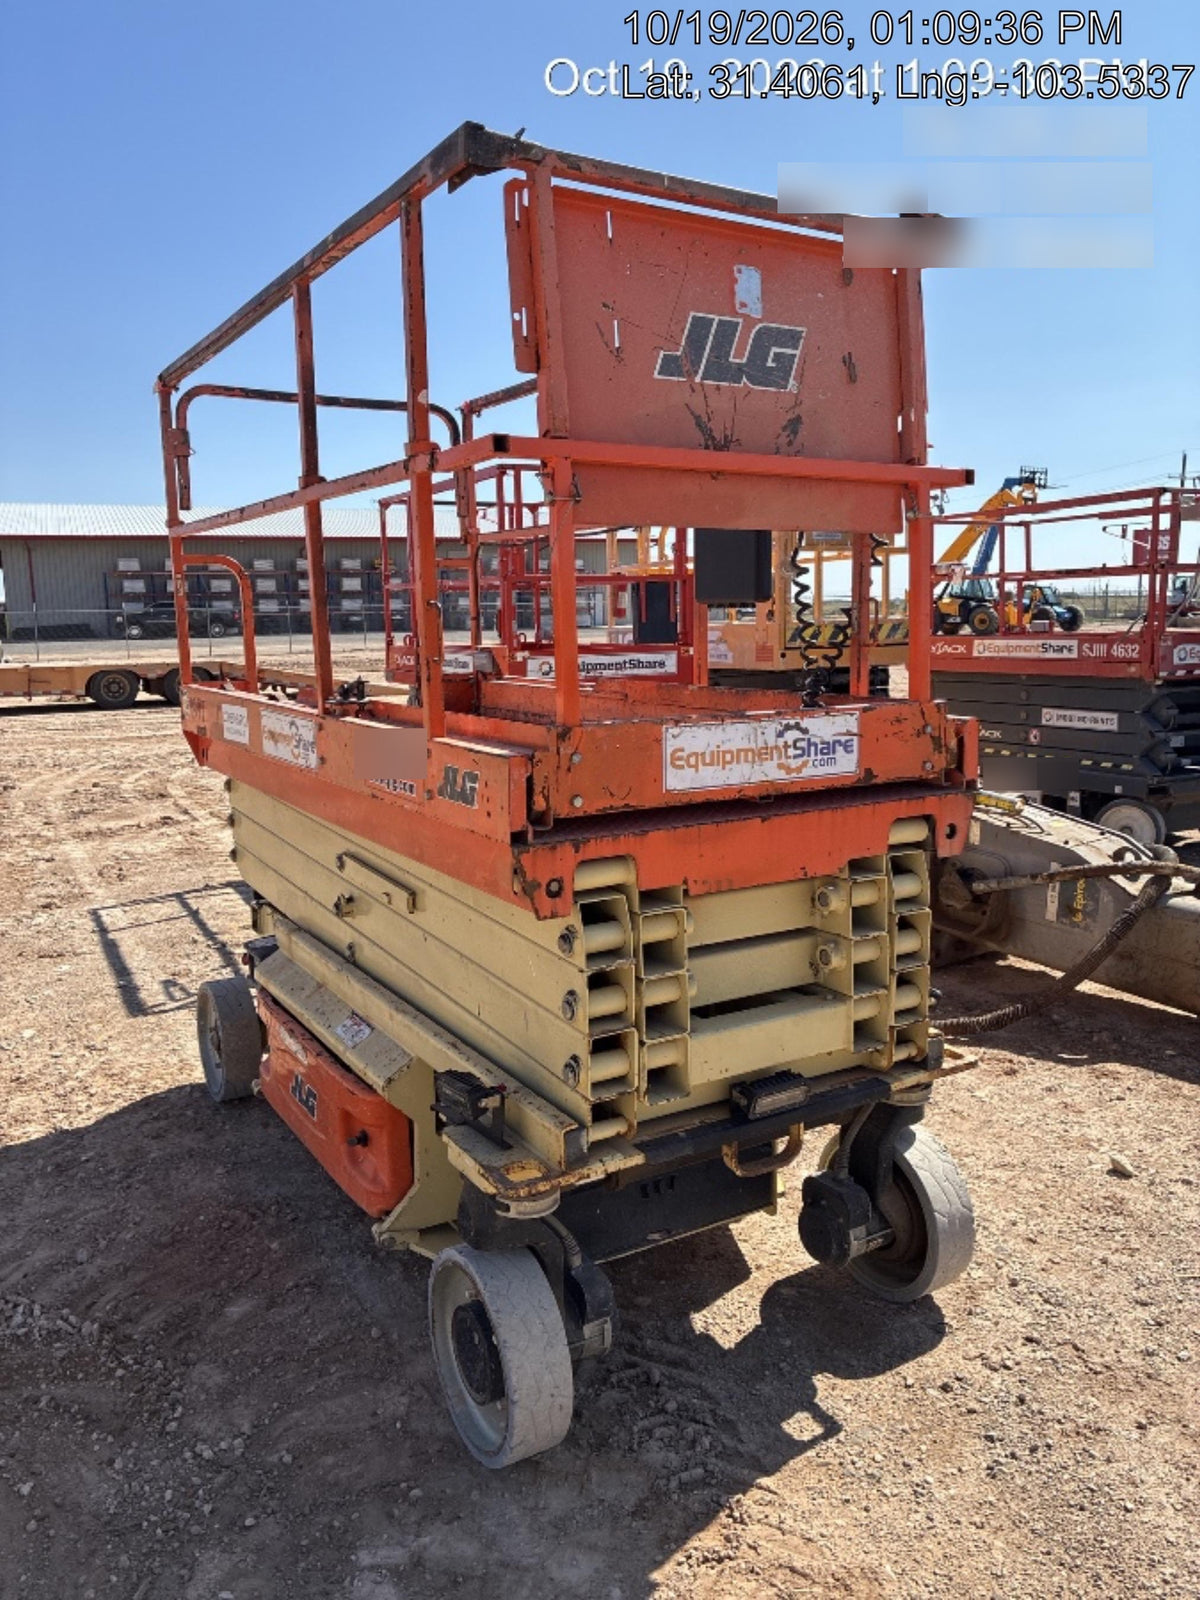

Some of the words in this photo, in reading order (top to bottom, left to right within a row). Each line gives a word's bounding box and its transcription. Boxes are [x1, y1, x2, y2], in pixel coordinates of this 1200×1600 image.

[653, 311, 807, 392] JLG
[987, 643, 1075, 655] EquipmentShare
[1111, 643, 1140, 658] 4632
[670, 737, 855, 774] EquipmentShare
[437, 764, 480, 809] JLG
[289, 1070, 318, 1122] JLG
